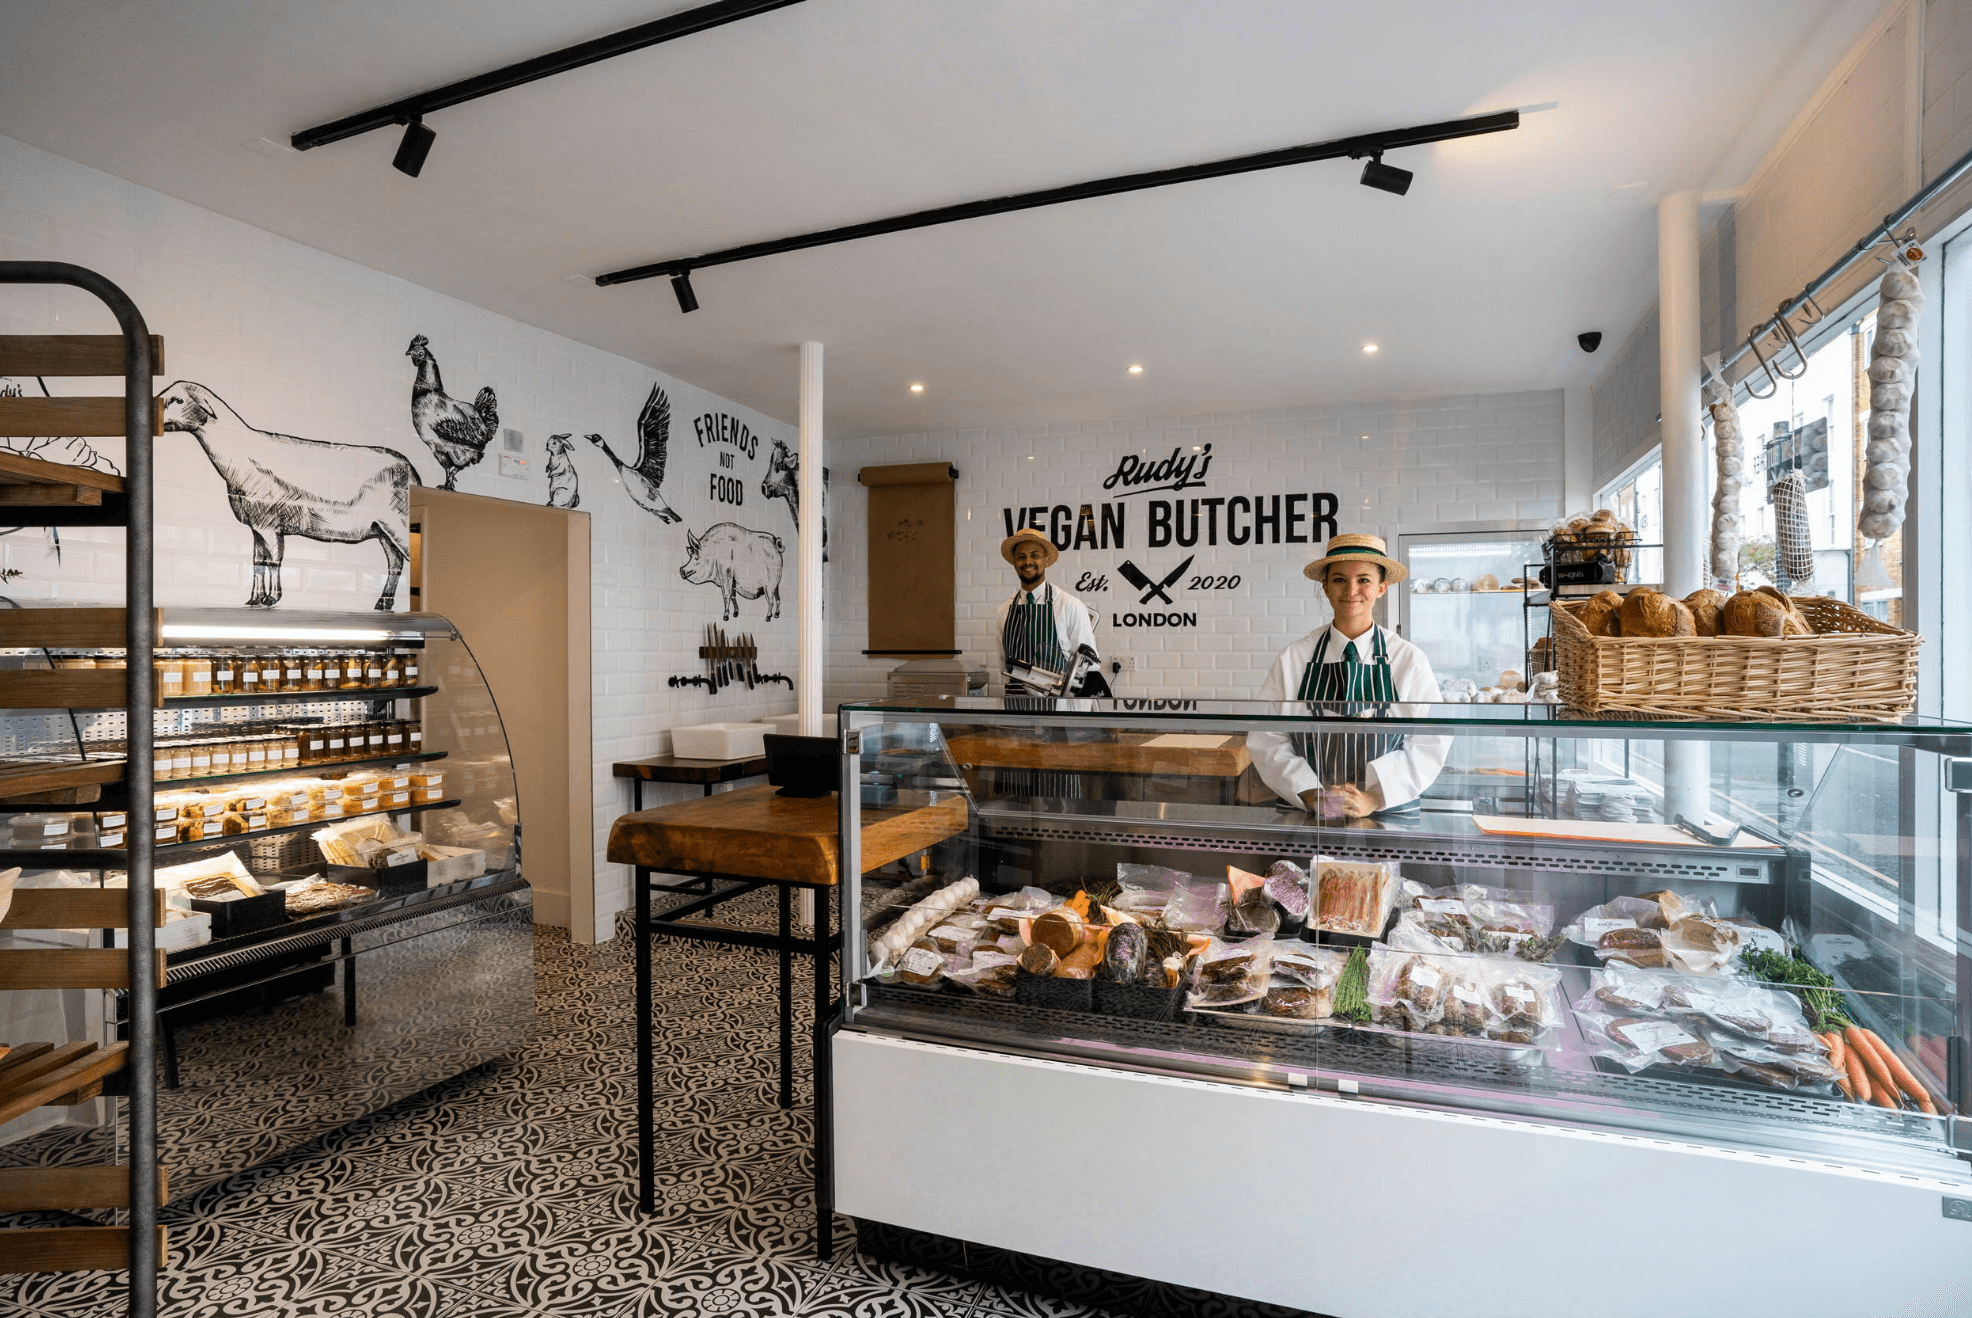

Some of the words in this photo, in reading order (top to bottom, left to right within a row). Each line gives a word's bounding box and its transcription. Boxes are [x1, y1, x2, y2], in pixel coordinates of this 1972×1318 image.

[693, 413, 758, 460] FRIENDS
[719, 451, 734, 470] NOT
[1103, 443, 1213, 498] Rudy's
[710, 473, 743, 506] FOOD
[1004, 502, 1125, 551] VEGAN
[1149, 493, 1339, 548] BUTCHER
[1075, 571, 1109, 592] Est.
[1187, 575, 1241, 591] 2020
[1113, 612, 1197, 628] LONDON
